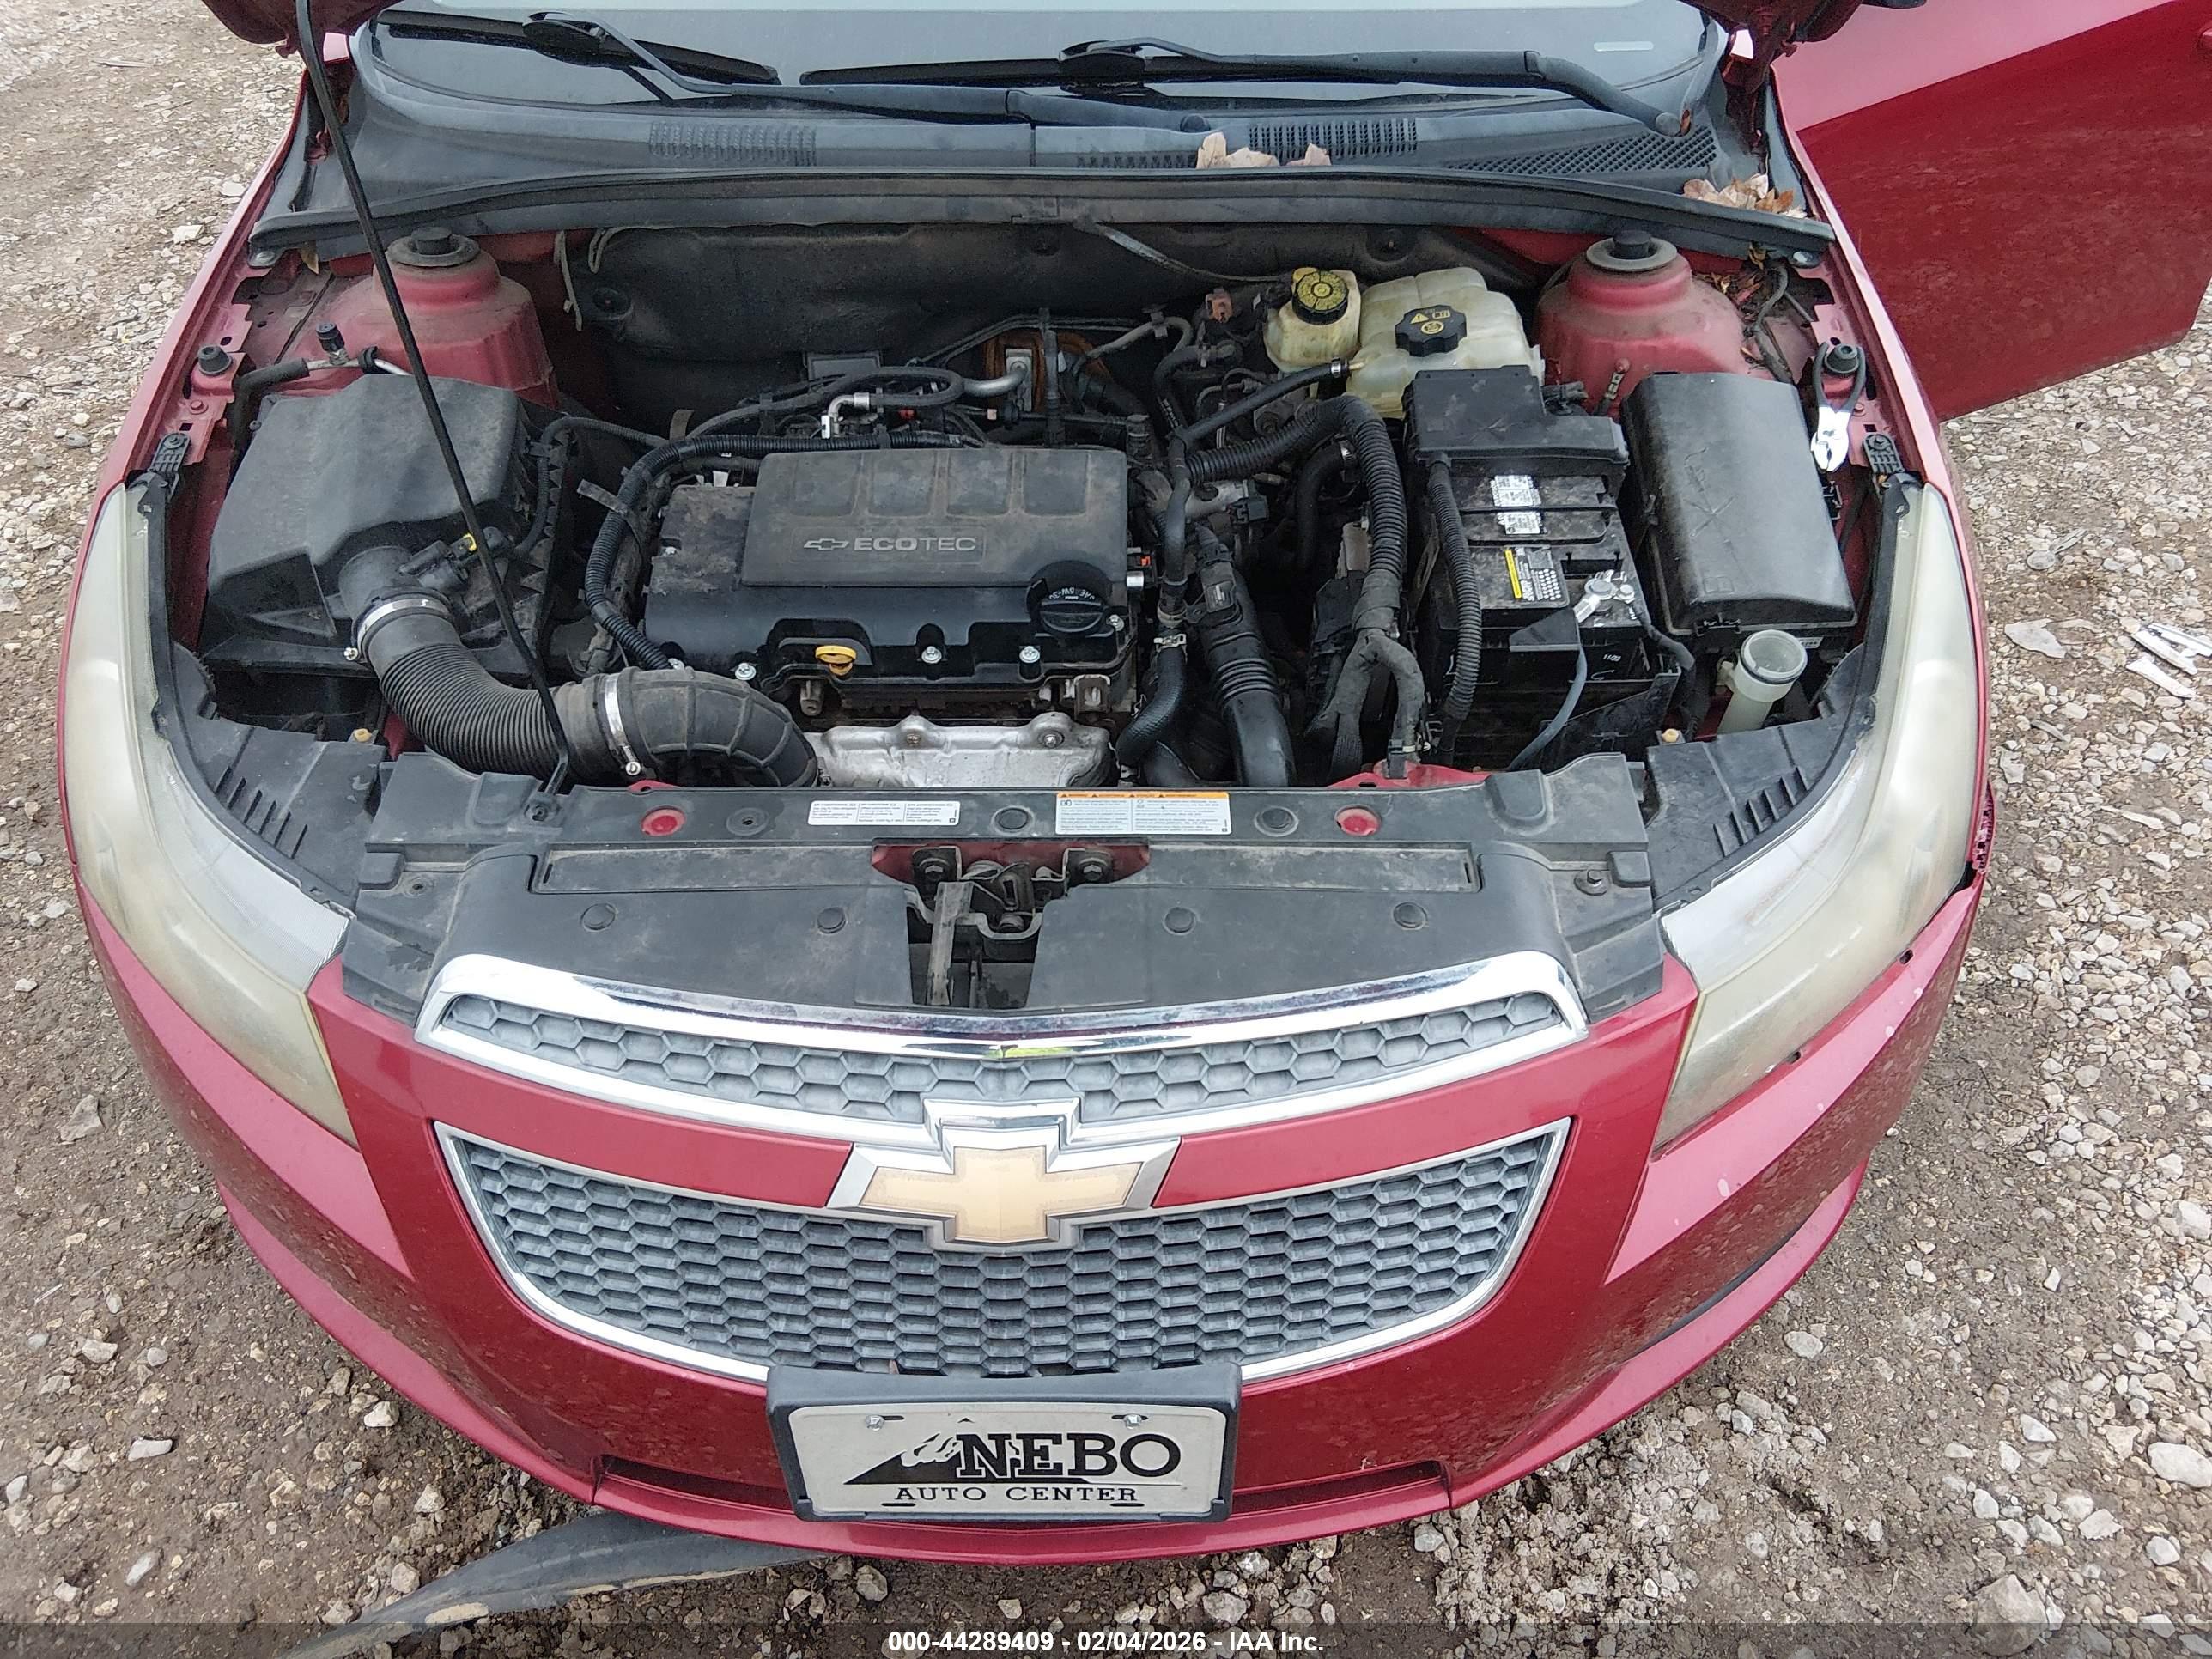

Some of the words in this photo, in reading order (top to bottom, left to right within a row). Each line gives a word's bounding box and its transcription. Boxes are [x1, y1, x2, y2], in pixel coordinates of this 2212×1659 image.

[854, 537, 977, 551] ECOTEC
[955, 1433, 1181, 1477] NEBO
[894, 1486, 987, 1501] AUTO
[1006, 1486, 1138, 1502] CENTER
